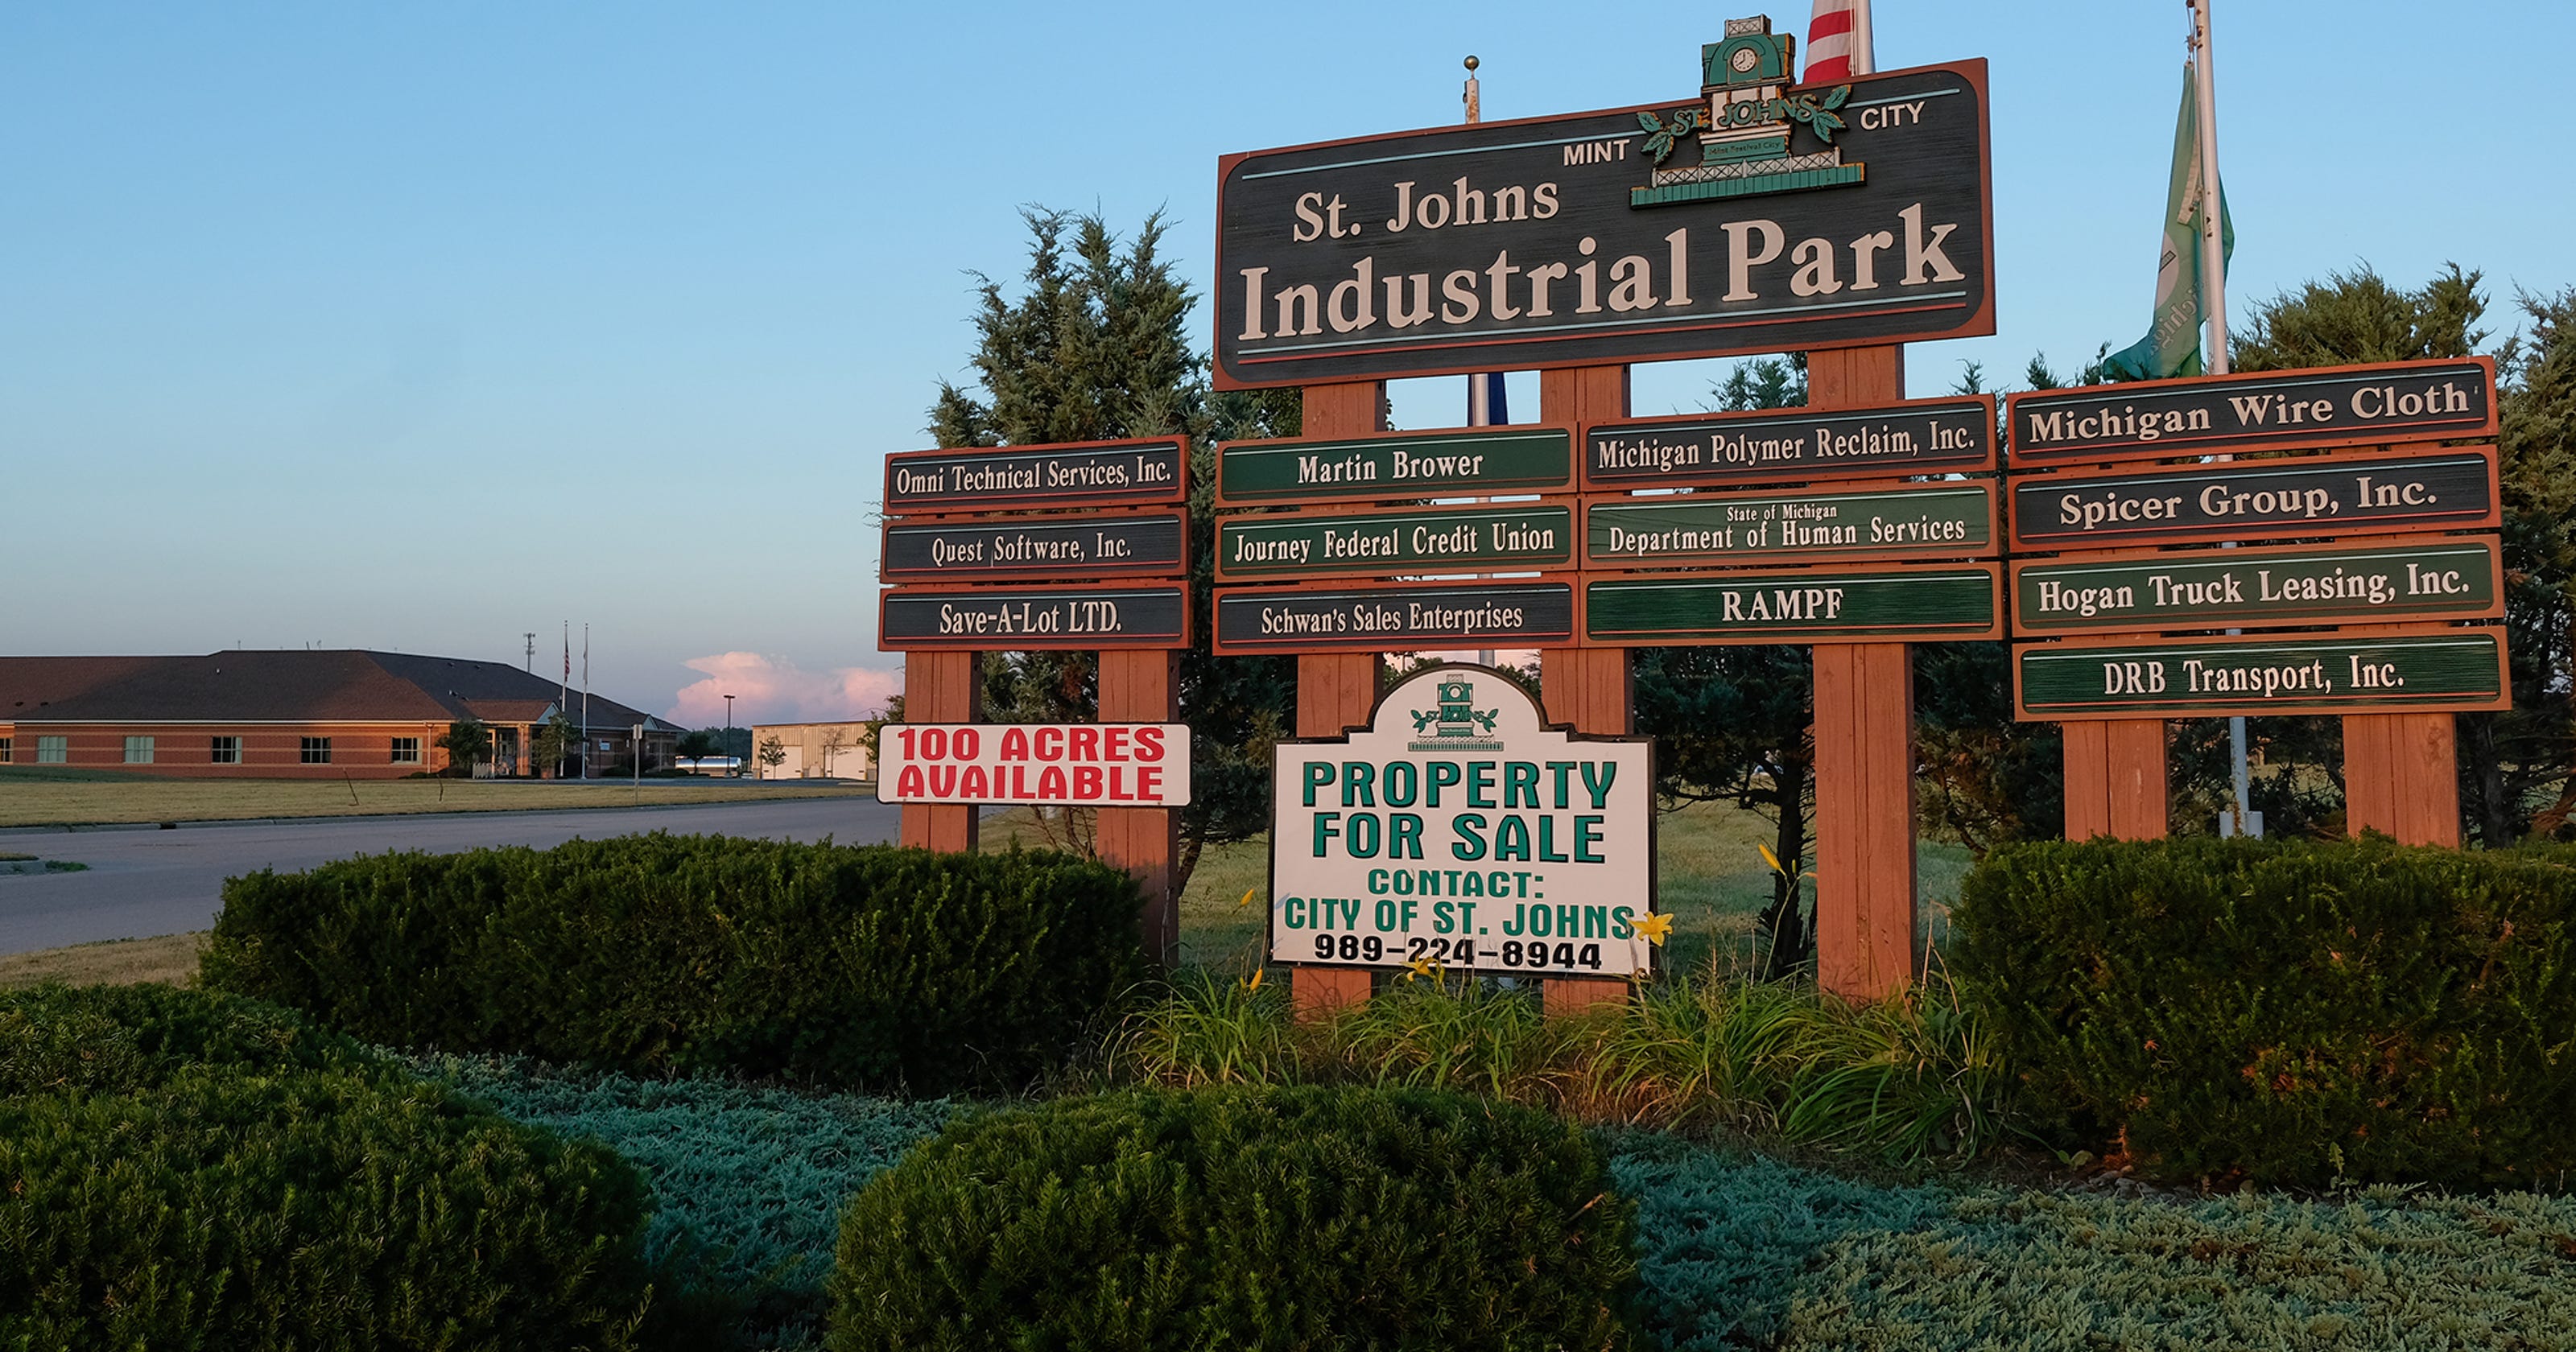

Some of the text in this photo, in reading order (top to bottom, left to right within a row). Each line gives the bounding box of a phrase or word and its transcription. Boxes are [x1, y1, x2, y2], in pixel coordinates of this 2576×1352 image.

[1718, 95, 1818, 126] JOHNS
[1860, 101, 1926, 130] CITY
[1563, 138, 1630, 167] MINT
[1293, 175, 1560, 242] St. Johns
[1237, 202, 1967, 340] Industrial Park
[2029, 381, 2471, 444] Michigan Wire Cloth
[1598, 420, 1975, 472] Michigan Polymer Reclaim, Inc.
[897, 455, 1171, 495] Omni Technical Services, Inc.
[1298, 451, 1484, 484] Martin Brower
[1727, 503, 1838, 522] State of Michigan
[2060, 476, 2438, 530] Spicer Group, Inc.
[931, 532, 1132, 567] Quest Software, Inc.
[1234, 521, 1555, 564] Journey Federal Credit Union
[1609, 514, 1966, 556] Department of Human Services
[1722, 588, 1844, 622] RAMPF
[2037, 563, 2471, 617] Hogan Truck Leasing, Inc.
[939, 600, 1123, 634] Save-A-Lot LTD.
[1261, 600, 1524, 635] Schwan's Sales Enterprises
[2103, 655, 2405, 698] DRB Transport, Inc.
[898, 727, 1166, 762] 100 ACRES
[897, 765, 1164, 802] AVAILABLE
[1302, 760, 1618, 810] PROPERTY
[1312, 812, 1606, 864] FOR SALE
[1368, 868, 1545, 899] CONTACT:
[1284, 897, 1636, 940] CITY OF ST. JOHNS
[1314, 934, 1603, 970] 989-224-8944
